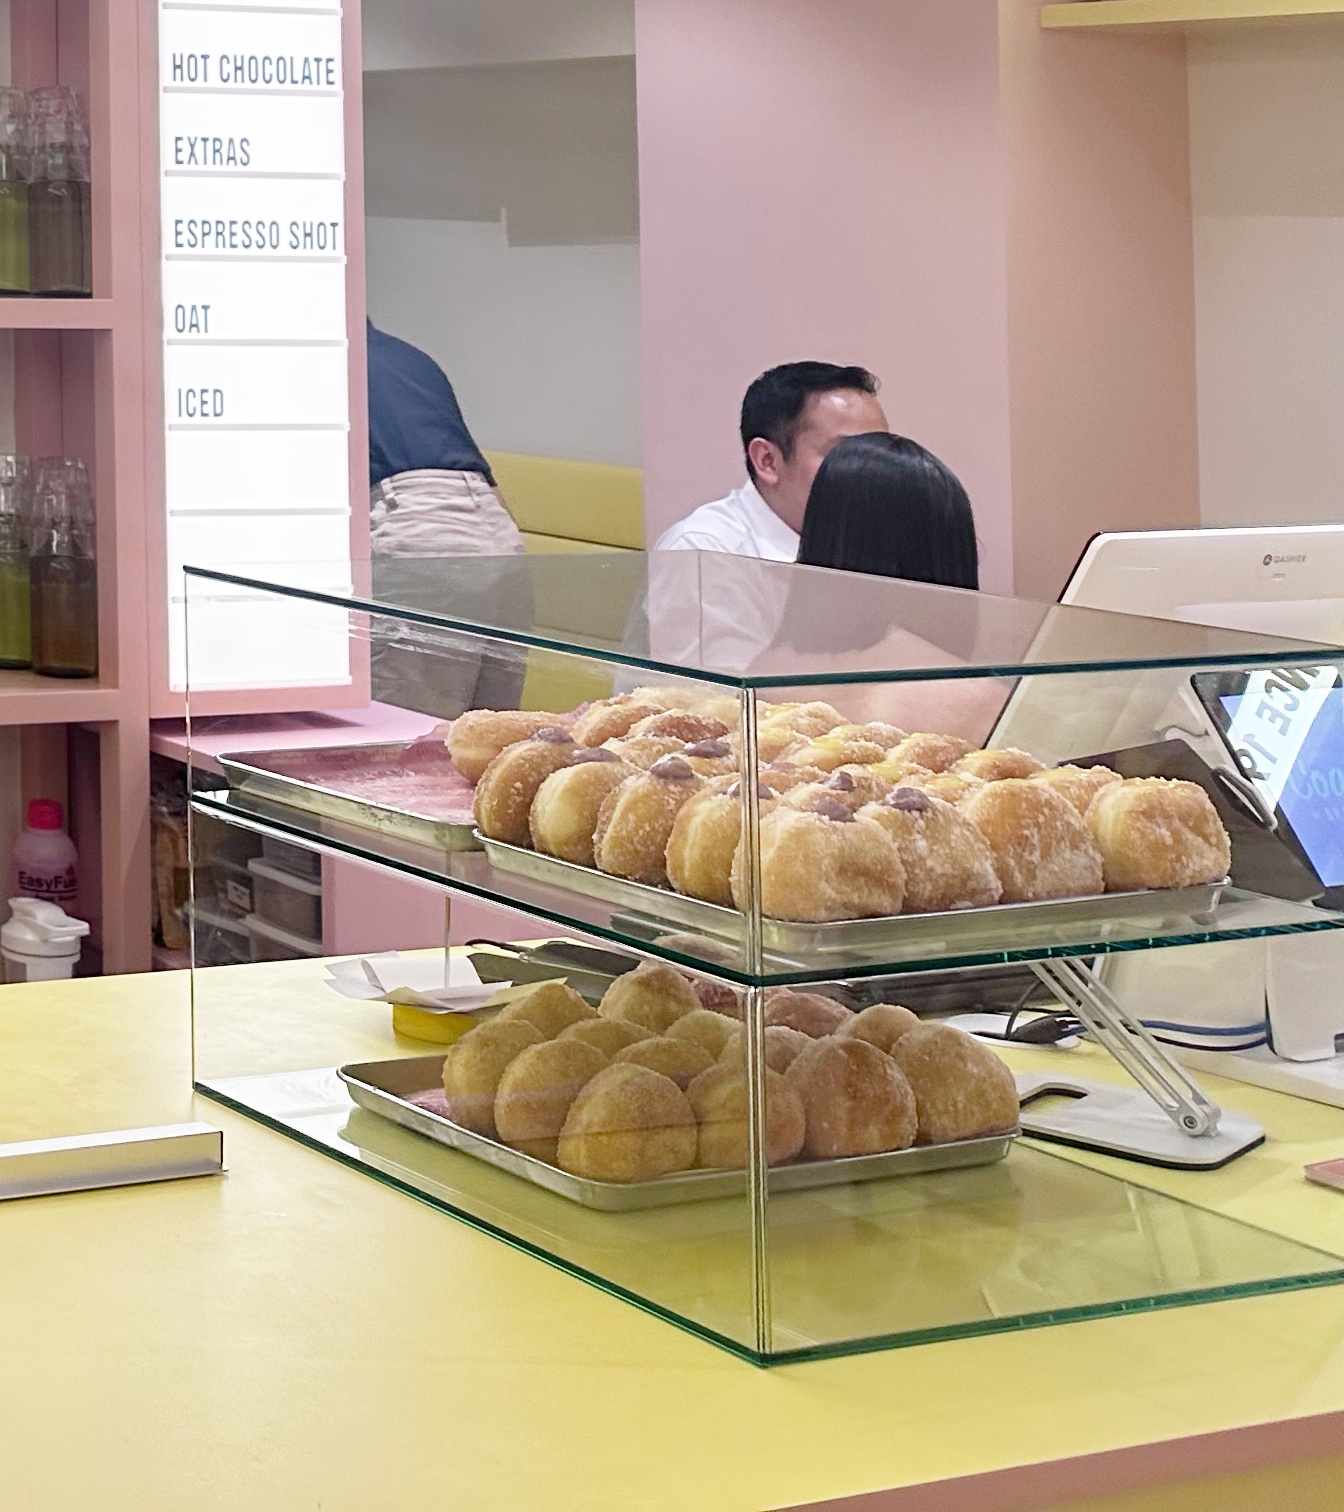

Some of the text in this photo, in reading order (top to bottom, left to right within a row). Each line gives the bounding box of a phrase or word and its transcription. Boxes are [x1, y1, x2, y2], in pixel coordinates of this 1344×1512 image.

[172, 53, 336, 86] HOT CHOCOLATE
[174, 136, 251, 167] EXTRAS
[174, 219, 340, 250] ESPRESSO SHOT
[175, 304, 211, 334] OAT
[177, 388, 225, 418] ICED
